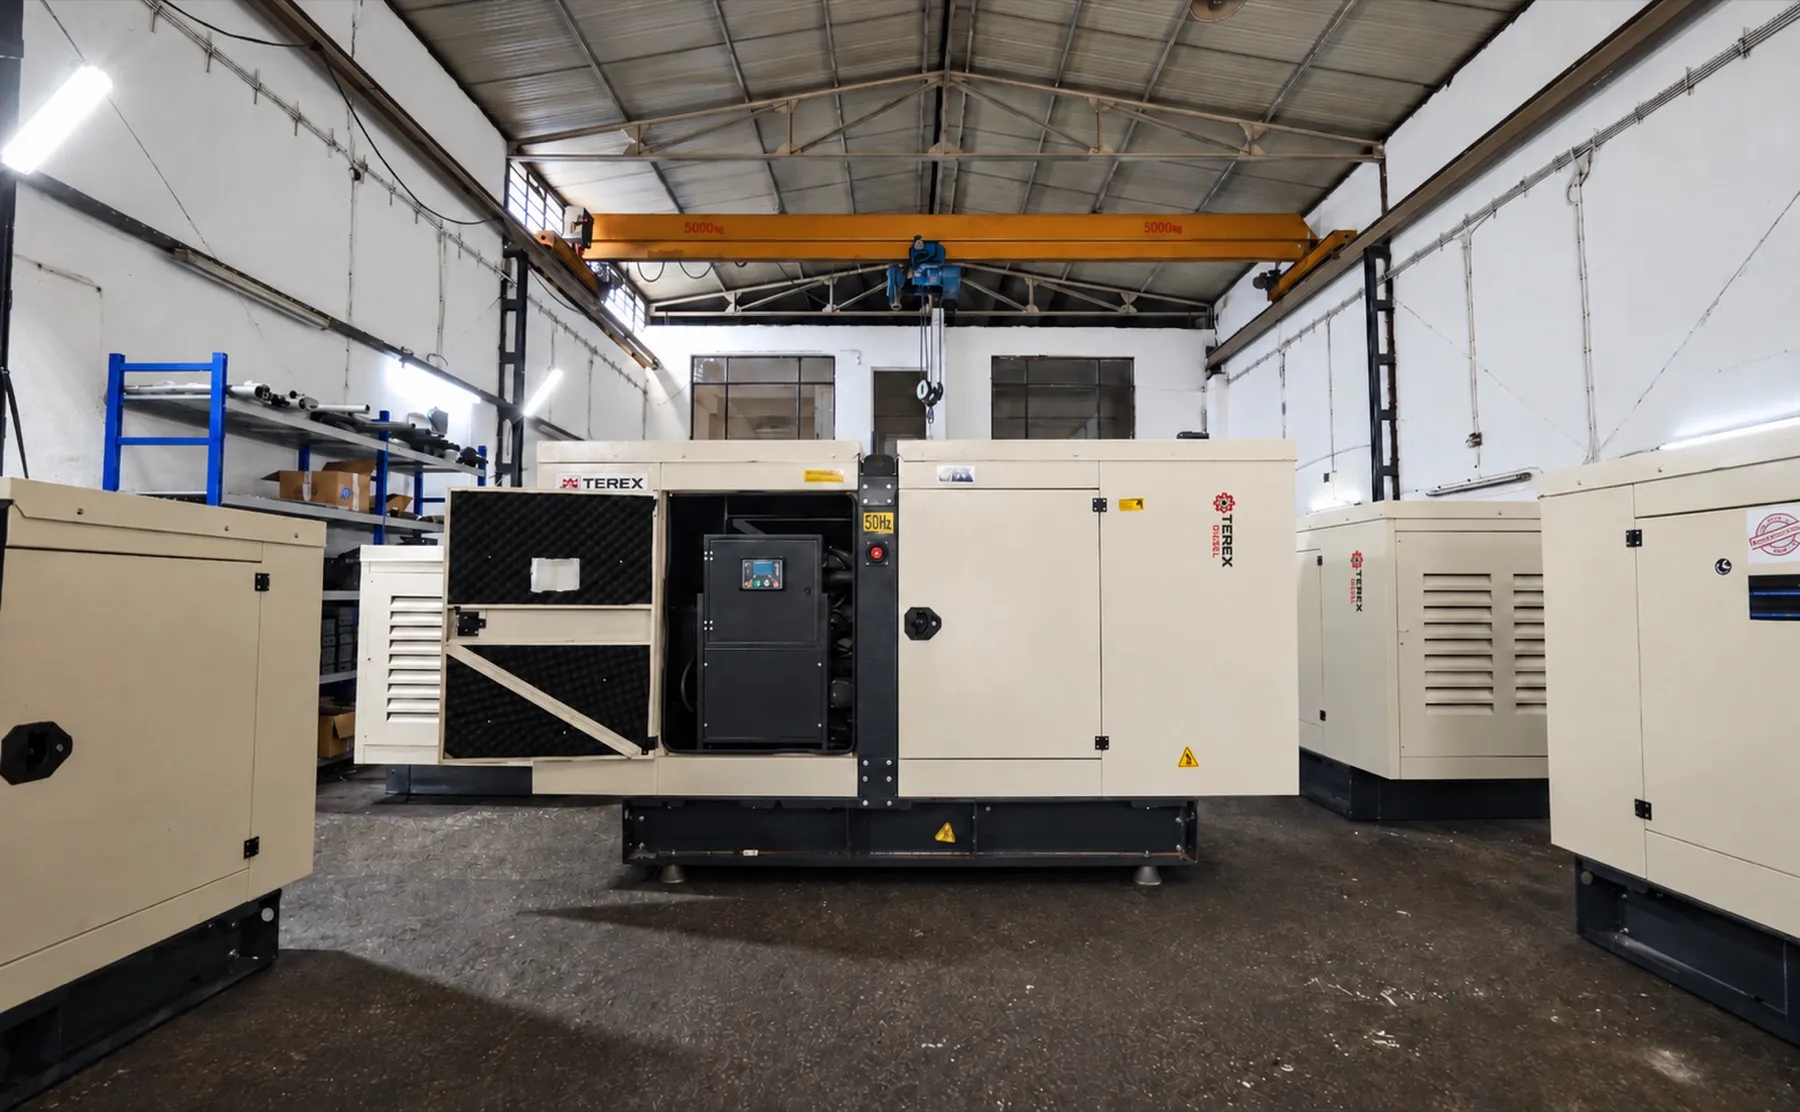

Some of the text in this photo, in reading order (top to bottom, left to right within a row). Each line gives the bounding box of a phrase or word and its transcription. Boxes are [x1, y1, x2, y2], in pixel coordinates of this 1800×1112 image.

[582, 477, 643, 489] TEREX
[864, 514, 893, 530] 50Hz
[1221, 513, 1233, 568] TEREX
